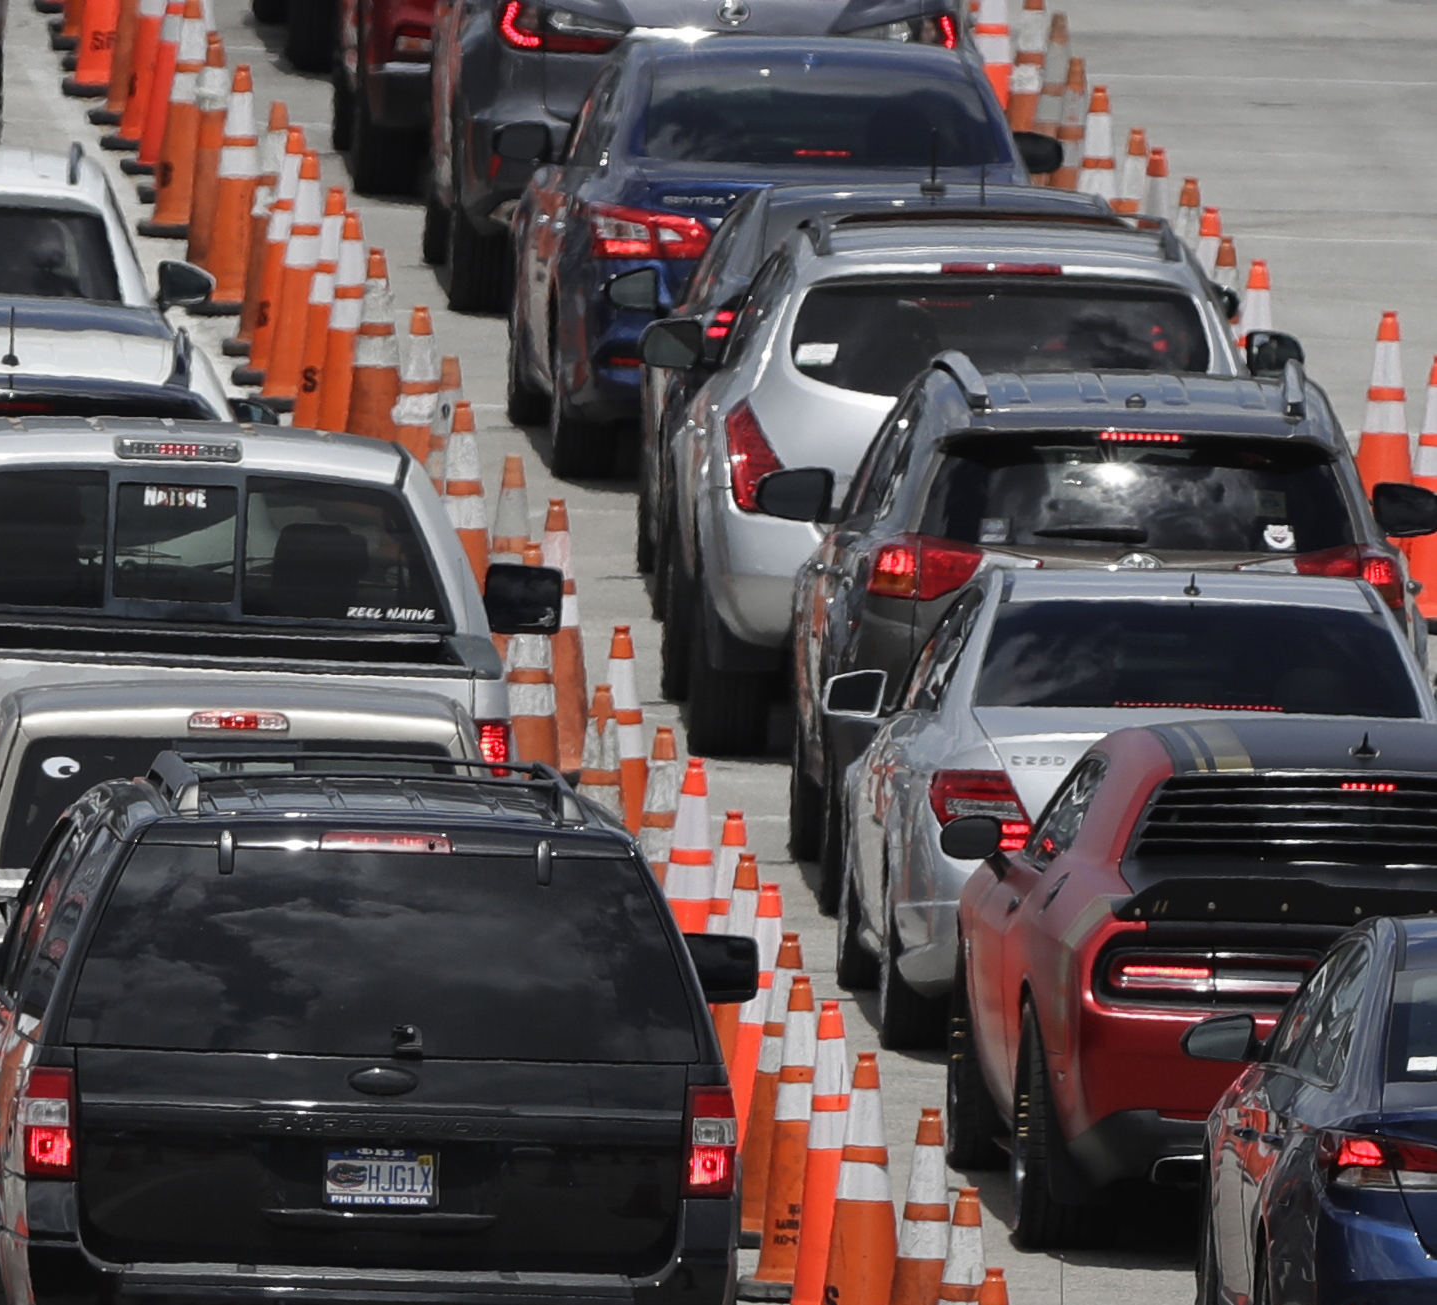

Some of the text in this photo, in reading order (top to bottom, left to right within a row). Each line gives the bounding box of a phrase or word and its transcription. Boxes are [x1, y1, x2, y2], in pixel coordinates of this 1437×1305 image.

[663, 195, 727, 207] SENTRA
[143, 485, 207, 508] NATIVE
[386, 607, 436, 621] NATIVE
[368, 1164, 432, 1194] HJG1X
[331, 1195, 429, 1206] PHI BETA SIGMA
